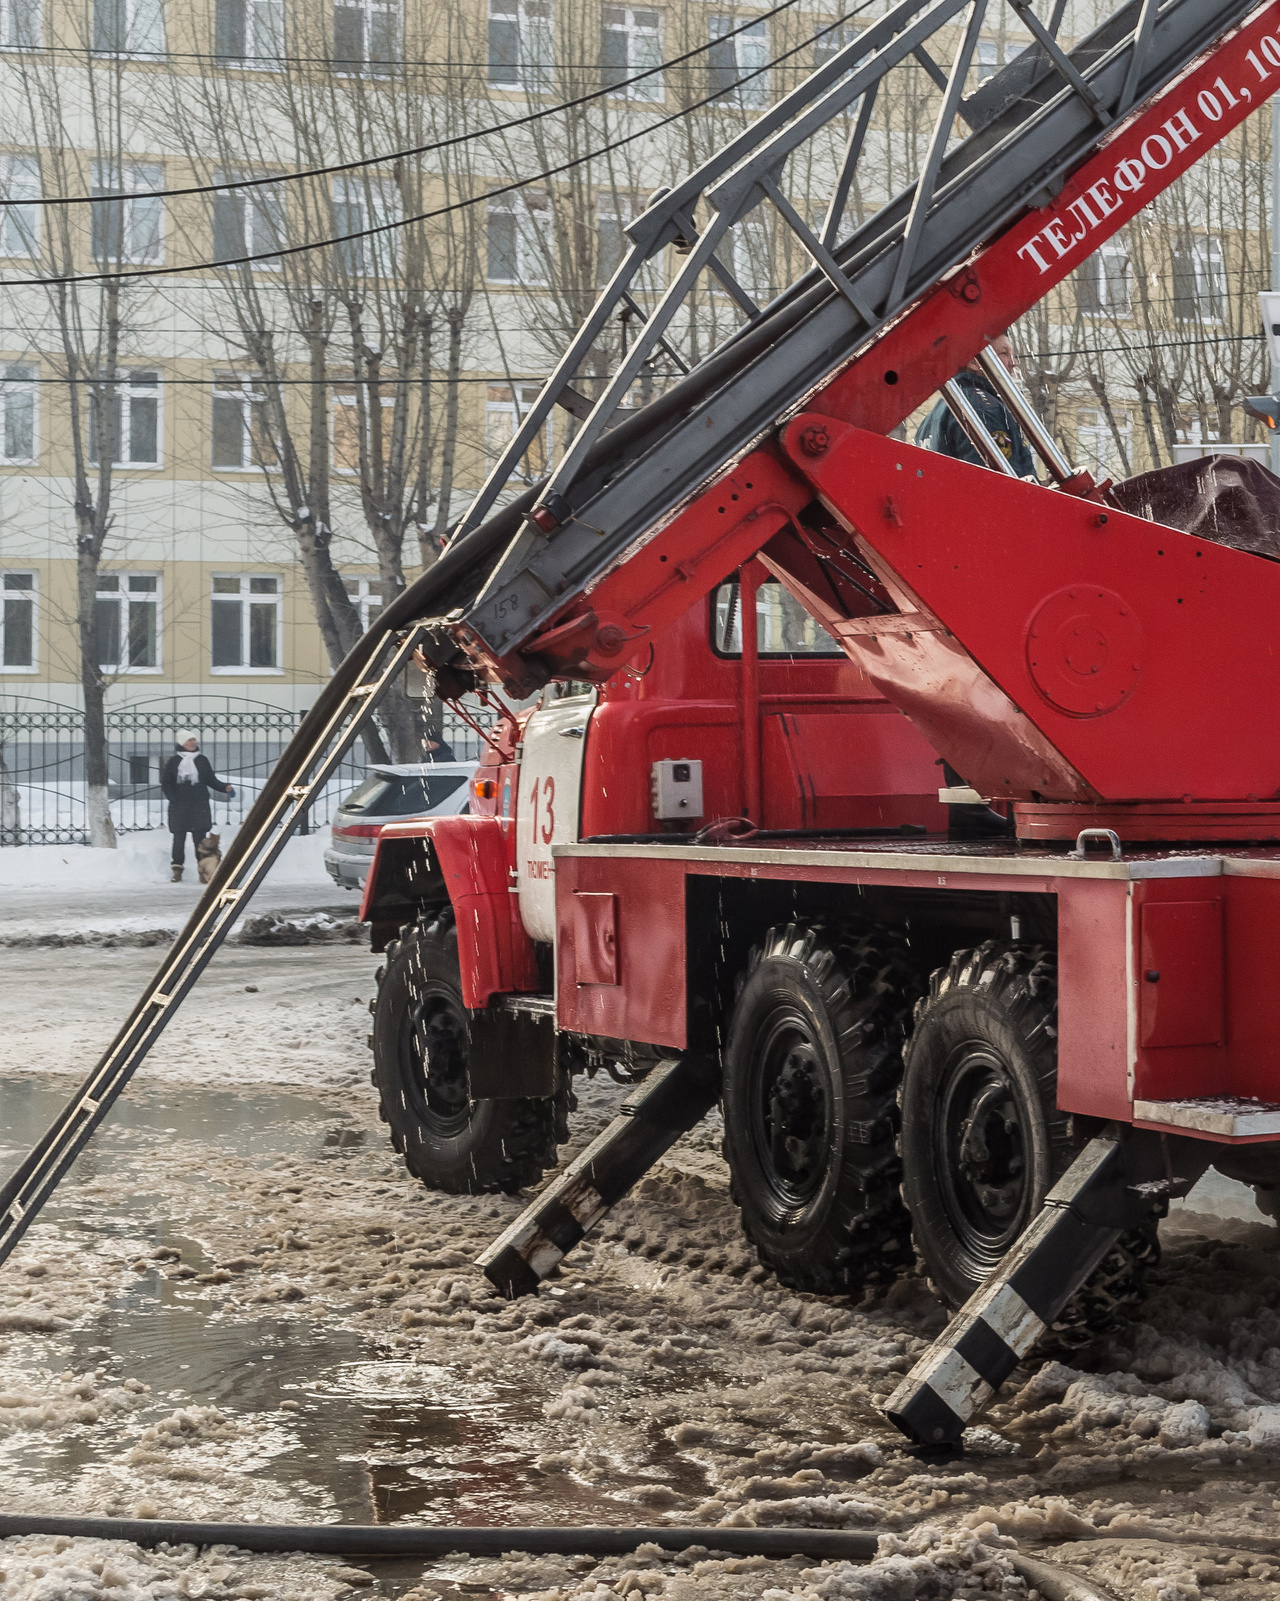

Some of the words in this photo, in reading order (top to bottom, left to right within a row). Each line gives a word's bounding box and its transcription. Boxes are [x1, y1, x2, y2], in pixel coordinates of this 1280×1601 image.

[1017, 107, 1203, 275] ТЕЛЕФОН
[1196, 76, 1253, 122] 01,
[494, 594, 518, 619] 158
[530, 776, 555, 844] 13
[527, 861, 553, 878] ТЮМЕН
